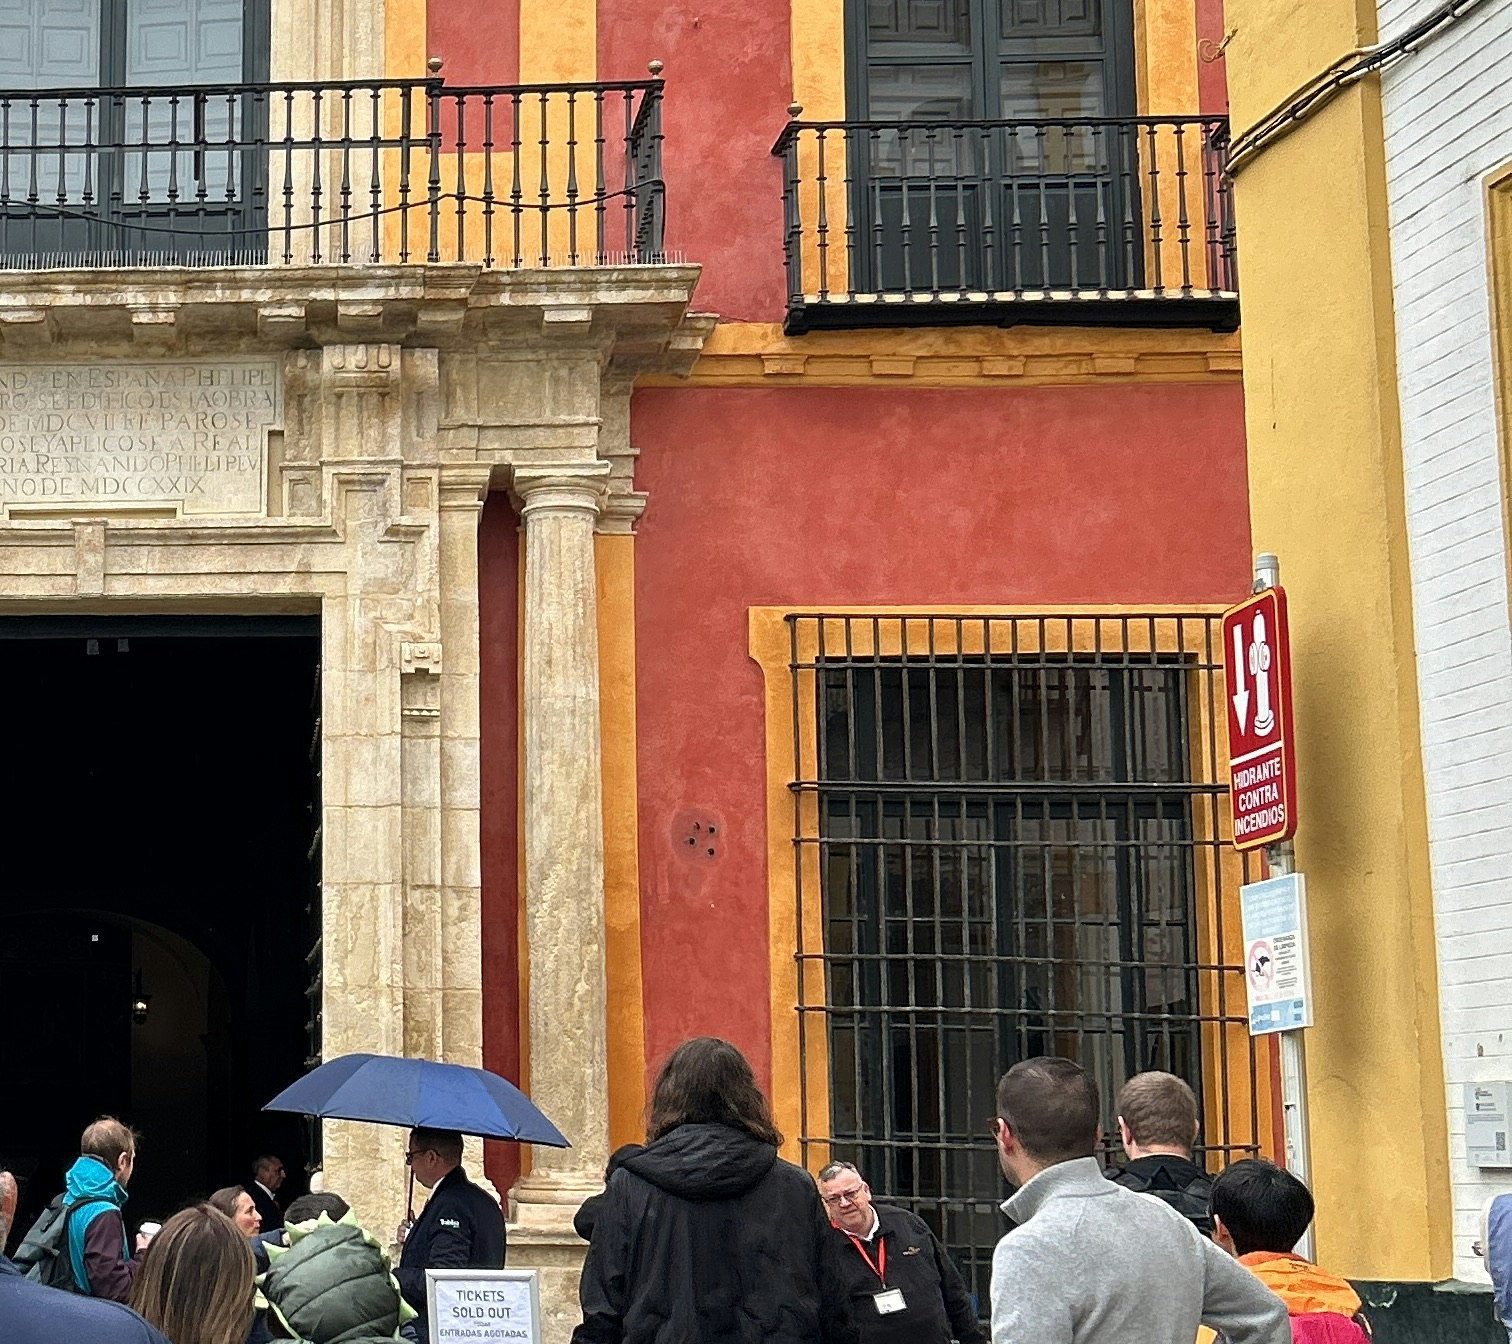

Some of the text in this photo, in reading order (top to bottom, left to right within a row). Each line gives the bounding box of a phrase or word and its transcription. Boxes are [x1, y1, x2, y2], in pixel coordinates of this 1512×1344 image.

[52, 371, 81, 389] EN
[169, 434, 185, 451] A
[193, 432, 259, 452] REAL
[35, 454, 165, 476] REYNANDO
[41, 477, 74, 496] DE
[80, 476, 206, 496] MDCCXXIX
[1234, 757, 1281, 791] HIDRANTE
[1238, 782, 1279, 812] CONTRA
[1235, 803, 1285, 837] INCENDIOS
[456, 1290, 505, 1302] TICKETS
[452, 1307, 512, 1319] SOLD OUT
[440, 1329, 528, 1339] ENTRADAS AGOTADAS
